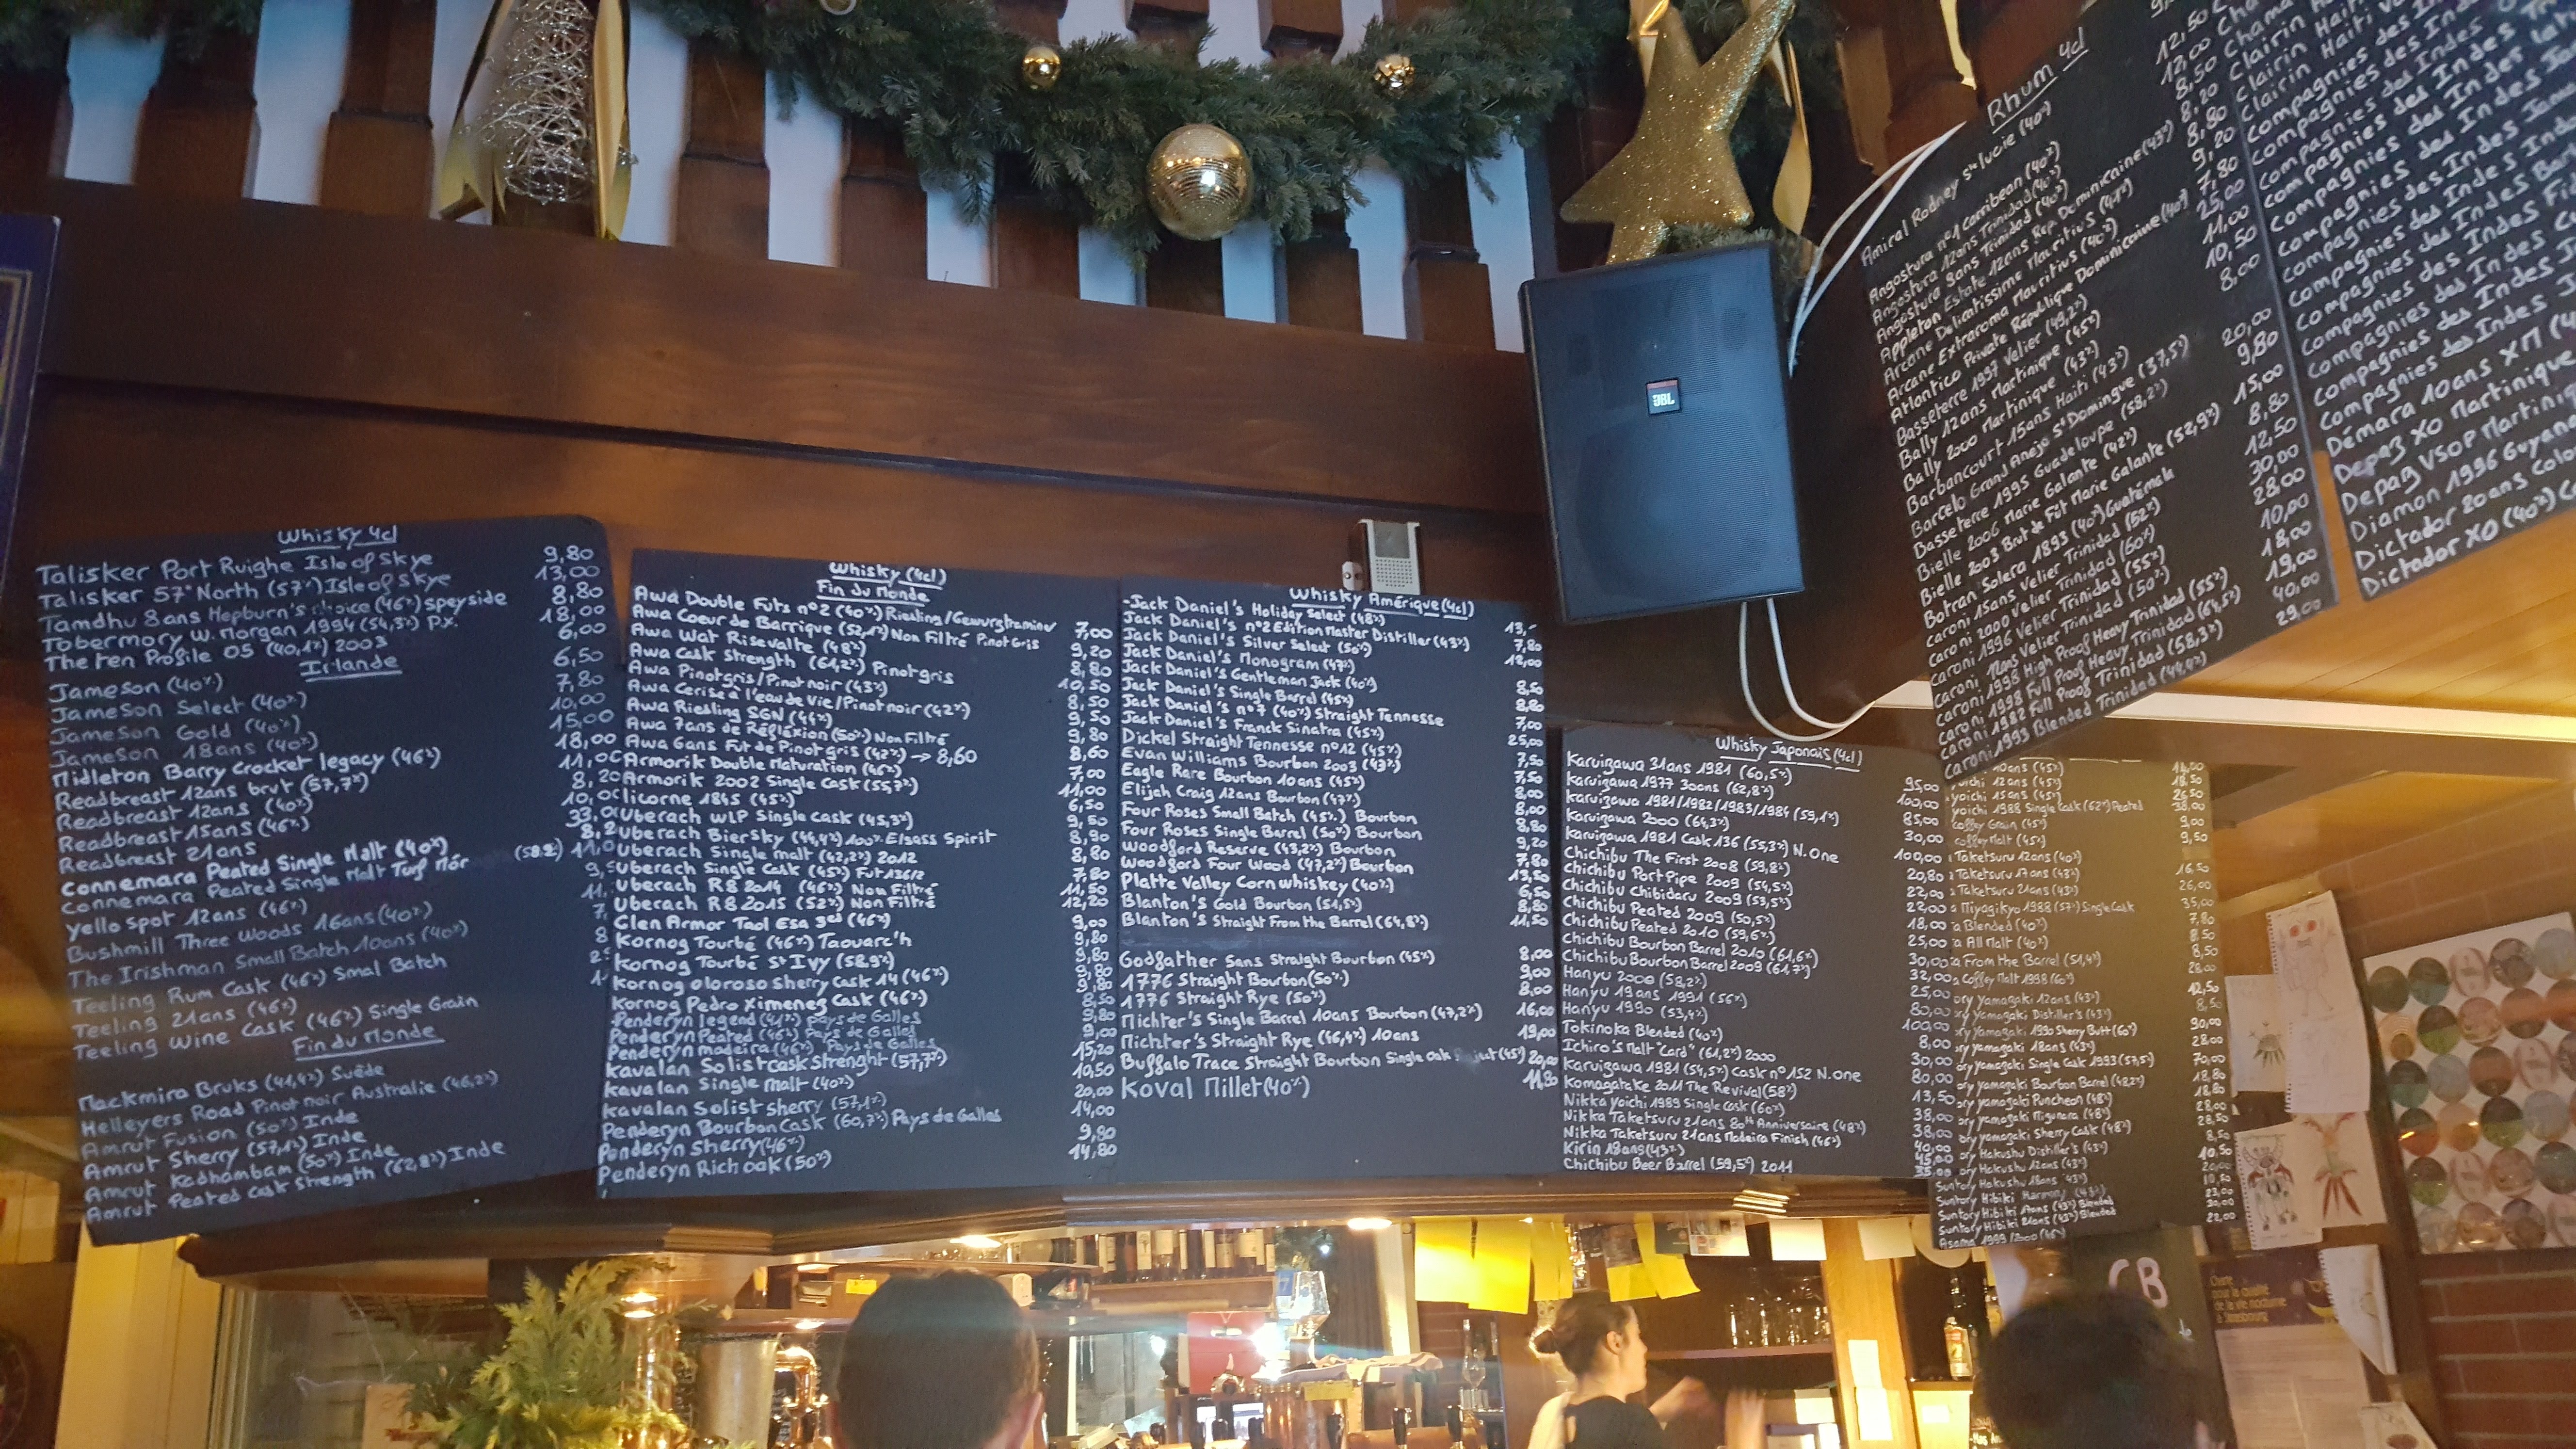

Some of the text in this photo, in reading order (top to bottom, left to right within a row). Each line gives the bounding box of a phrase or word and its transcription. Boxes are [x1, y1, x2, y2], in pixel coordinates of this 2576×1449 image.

[1987, 64, 2054, 125] Rhum
[1861, 179, 1960, 266] Amiral Rodney
[1868, 251, 1934, 306] Angostura
[1964, 333, 2008, 368] Private
[2234, 364, 2284, 405] 15,00
[1653, 393, 1675, 406] JBL
[1899, 436, 1938, 470] Bally
[1991, 344, 2061, 399] Martinique
[1908, 440, 2004, 515] Barbancourt
[278, 527, 365, 553] Whisky
[2063, 522, 2121, 564] Trinidad
[35, 545, 594, 585] Talisker Port Ruighe 9,80
[2266, 548, 2318, 581] 19,00
[2360, 537, 2460, 595] Dictador
[38, 565, 600, 609] Talisker North 13,00
[634, 585, 745, 611] Awa Double
[816, 579, 844, 596] Fin
[873, 586, 930, 605] Monde
[1924, 559, 2027, 629] Botran Solera
[1289, 587, 1440, 617] Whisky Amérique
[42, 632, 183, 654] Tobermory
[632, 603, 672, 620] Awa
[729, 613, 750, 628] de
[755, 615, 832, 639] Barrique
[1070, 642, 1112, 660] 9,20
[1123, 627, 1331, 653] Jack Daniel's Silver Select
[145, 635, 388, 666] Profile 2003
[299, 654, 402, 679] Irlande
[48, 681, 160, 703] Jameson
[177, 696, 243, 715] Select
[556, 670, 604, 692] 7,80
[176, 692, 605, 741] Gold 10,00
[1314, 707, 1444, 727] Straight Tennesse
[2033, 676, 2157, 737] Blended Trinidad
[1122, 727, 1176, 746] Dickel
[1181, 731, 1243, 752] Straight
[1245, 735, 1314, 752] Tennesse
[1715, 736, 1832, 762] Whisky Japonais
[623, 752, 857, 775] Armorik Double Maturation
[936, 746, 978, 768] 8,60
[1121, 746, 1357, 773] Evan Williams Bourbon 2003
[1695, 762, 1731, 775] 1981
[163, 763, 226, 787] Barry
[715, 774, 759, 789] 2002
[1121, 762, 1164, 783] Eagle
[1171, 762, 1207, 781] Rare
[1176, 784, 1215, 804] Craig
[1121, 801, 1296, 822] Four Roses Small Batch
[206, 858, 270, 881] Peated
[276, 852, 335, 874] Single
[710, 845, 767, 865] Single
[1564, 844, 1628, 865] Chichibu
[1633, 849, 1660, 864] The
[1665, 852, 1699, 866] First
[1703, 856, 1739, 872] 2008
[1121, 871, 1177, 891] Platte
[1181, 875, 1231, 900] Valley
[1518, 884, 1551, 900] 6,50
[1213, 895, 1313, 911] Gold Bourbon
[1562, 895, 1724, 924] Chichibu Peated 2009
[693, 935, 757, 952] Tourbé
[1964, 952, 2059, 967] From Barrel
[1120, 970, 1243, 992] 1776 Straight
[1563, 964, 1611, 989] Hanyu
[167, 986, 213, 1005] Rum
[1562, 1019, 1951, 1050] Tokinoka Blended 8,00
[699, 1076, 760, 1095] Single
[1122, 1076, 1193, 1099] Koval
[1563, 1125, 1607, 1139] Nikka
[1068, 1143, 1117, 1160] 14,80
[1563, 1140, 1601, 1156] Kirin
[598, 1157, 739, 1186] Penderyn Rich
[1632, 1157, 1662, 1171] Beer
[1665, 1157, 1705, 1171] Barrel
[168, 1189, 241, 1208] Peated
